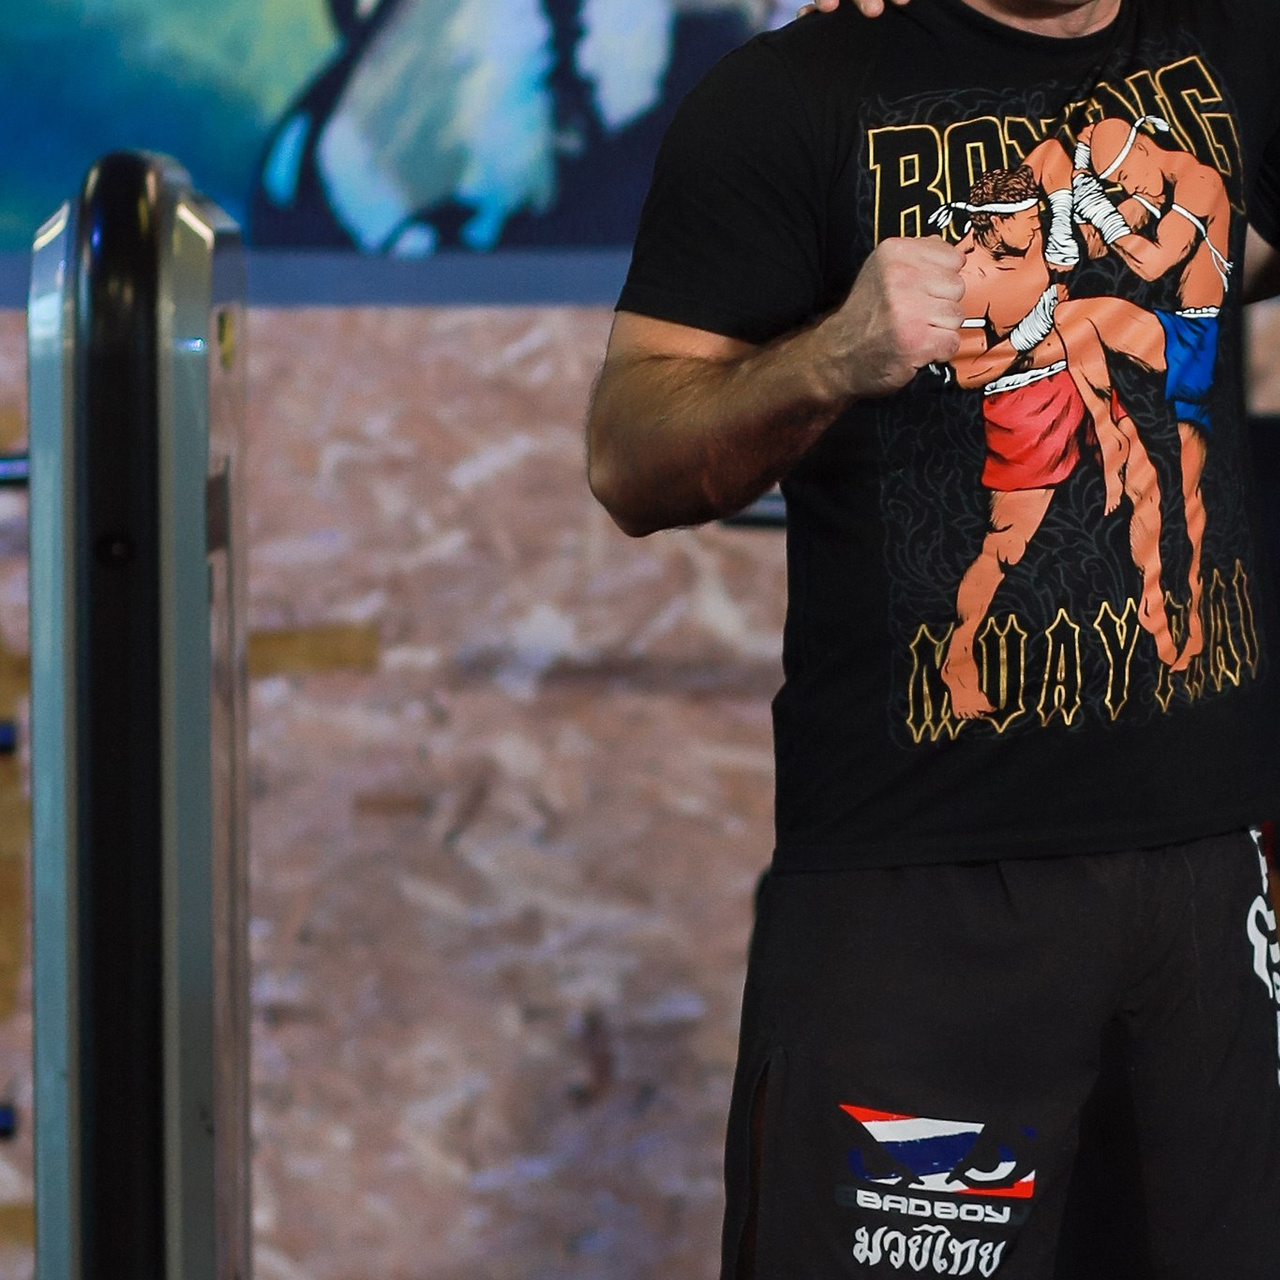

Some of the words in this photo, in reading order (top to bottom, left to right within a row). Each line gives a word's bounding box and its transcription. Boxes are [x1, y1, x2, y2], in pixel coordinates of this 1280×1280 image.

[856, 1189, 1011, 1223] BADBOY
[853, 1224, 1006, 1278] มวยไทย
